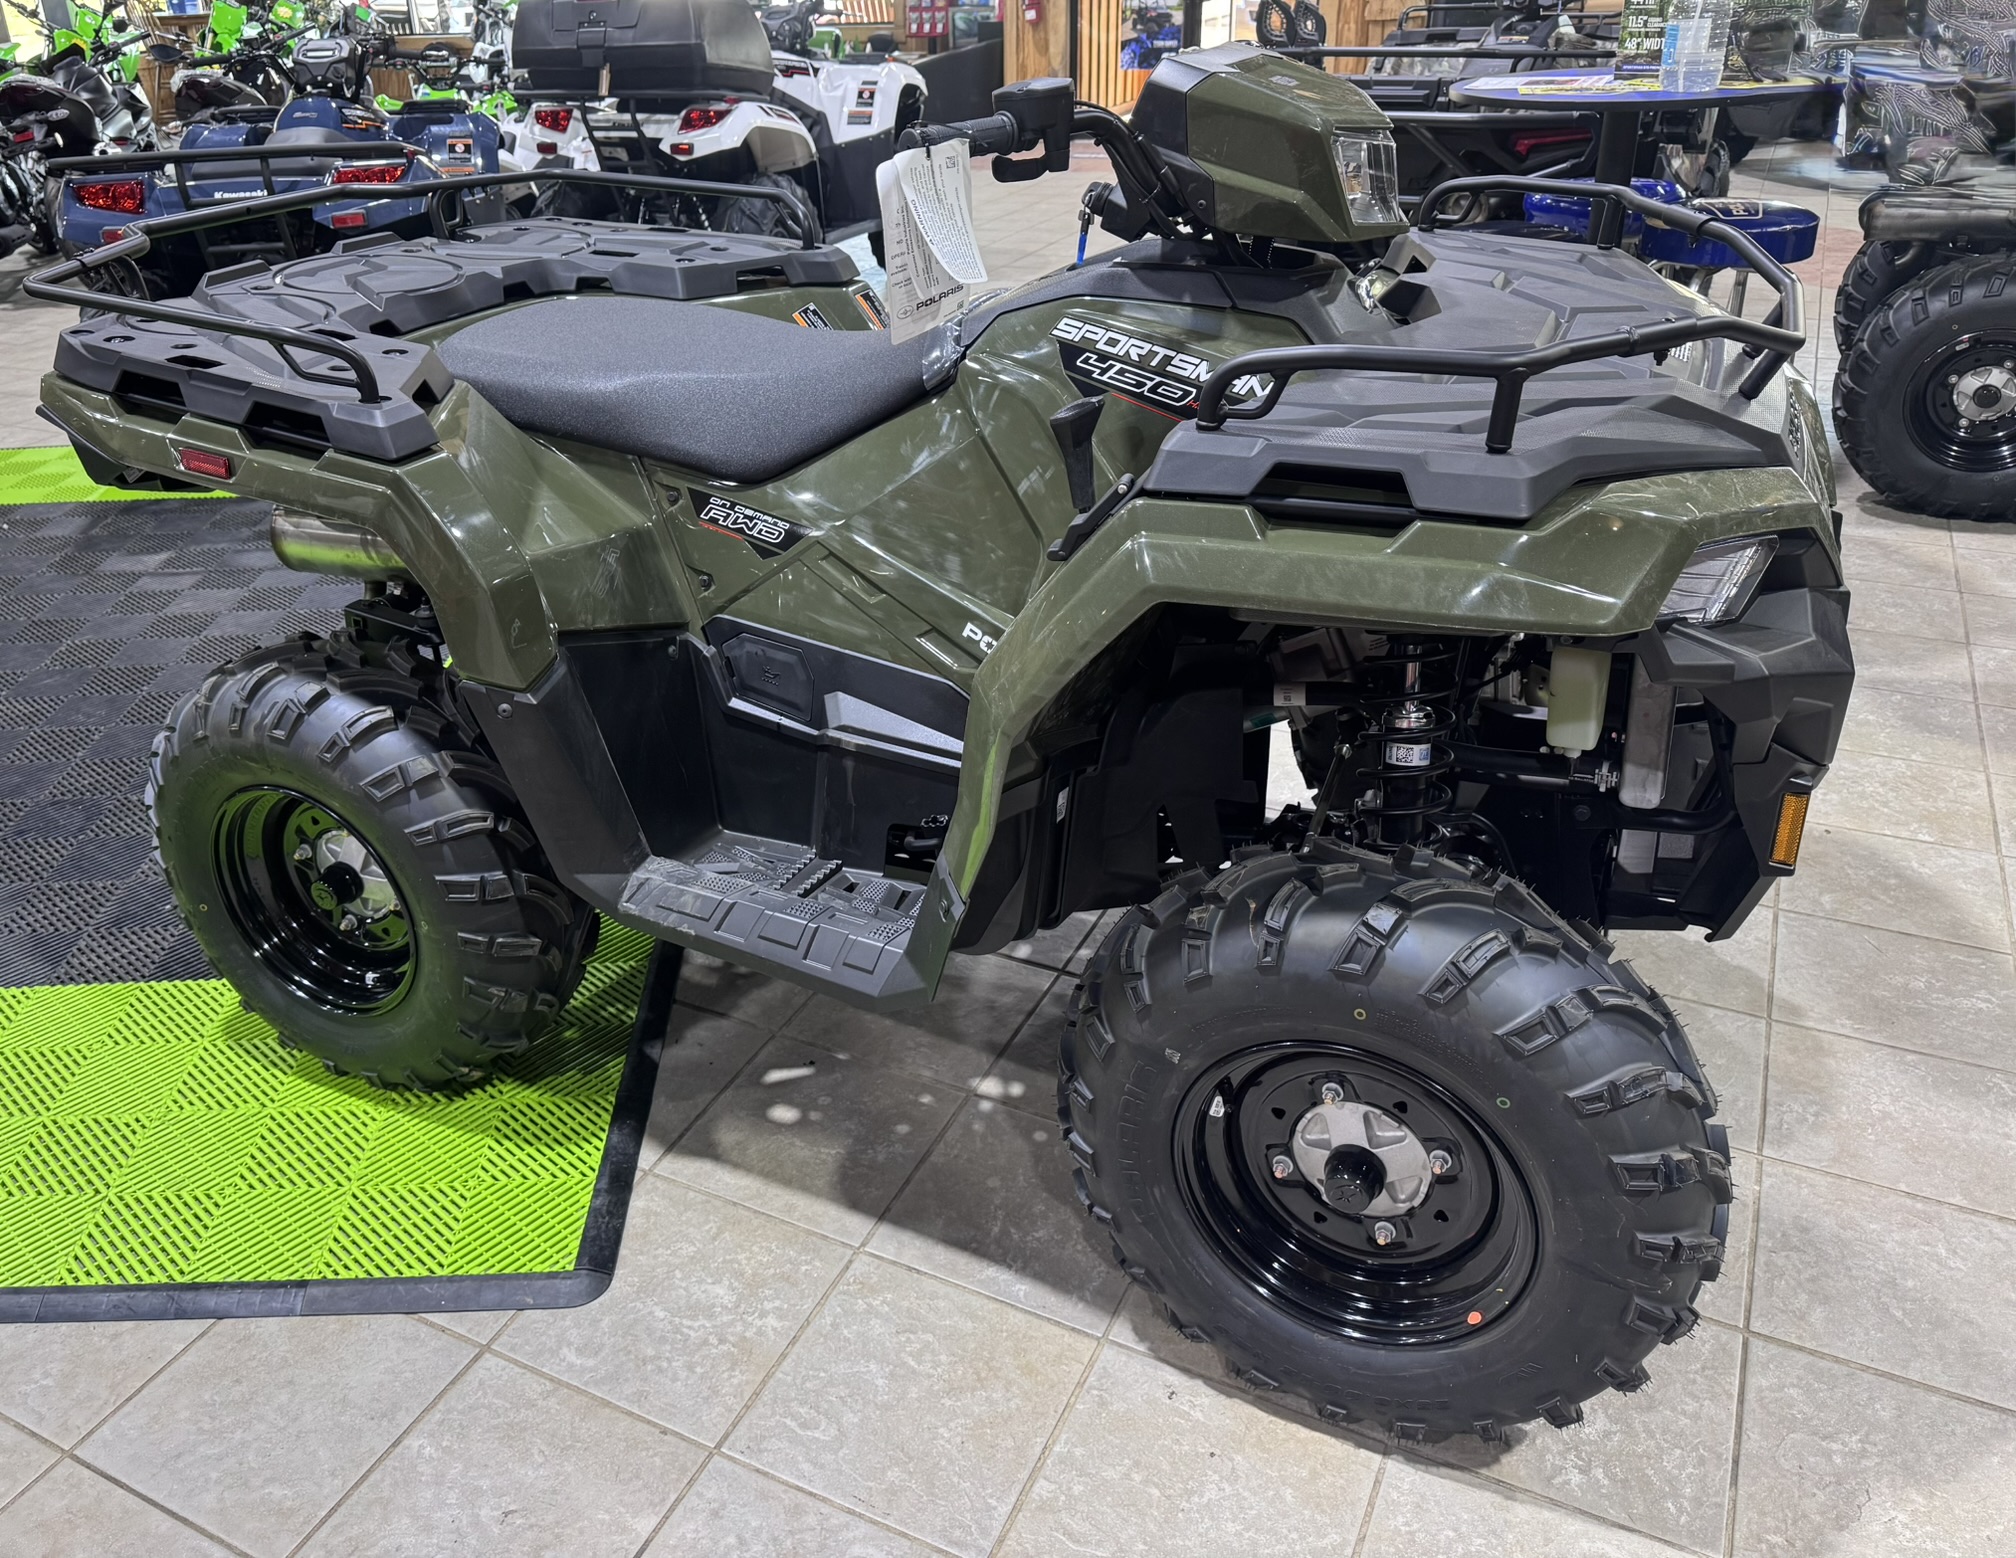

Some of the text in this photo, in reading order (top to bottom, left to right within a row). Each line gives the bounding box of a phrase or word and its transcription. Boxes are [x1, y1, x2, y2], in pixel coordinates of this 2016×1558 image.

[1624, 37, 1666, 50] 48" WIDT
[214, 189, 268, 199] Kawasaki
[916, 284, 964, 311] POLARIS
[1076, 352, 1197, 407] 450
[700, 504, 785, 543] AWD
